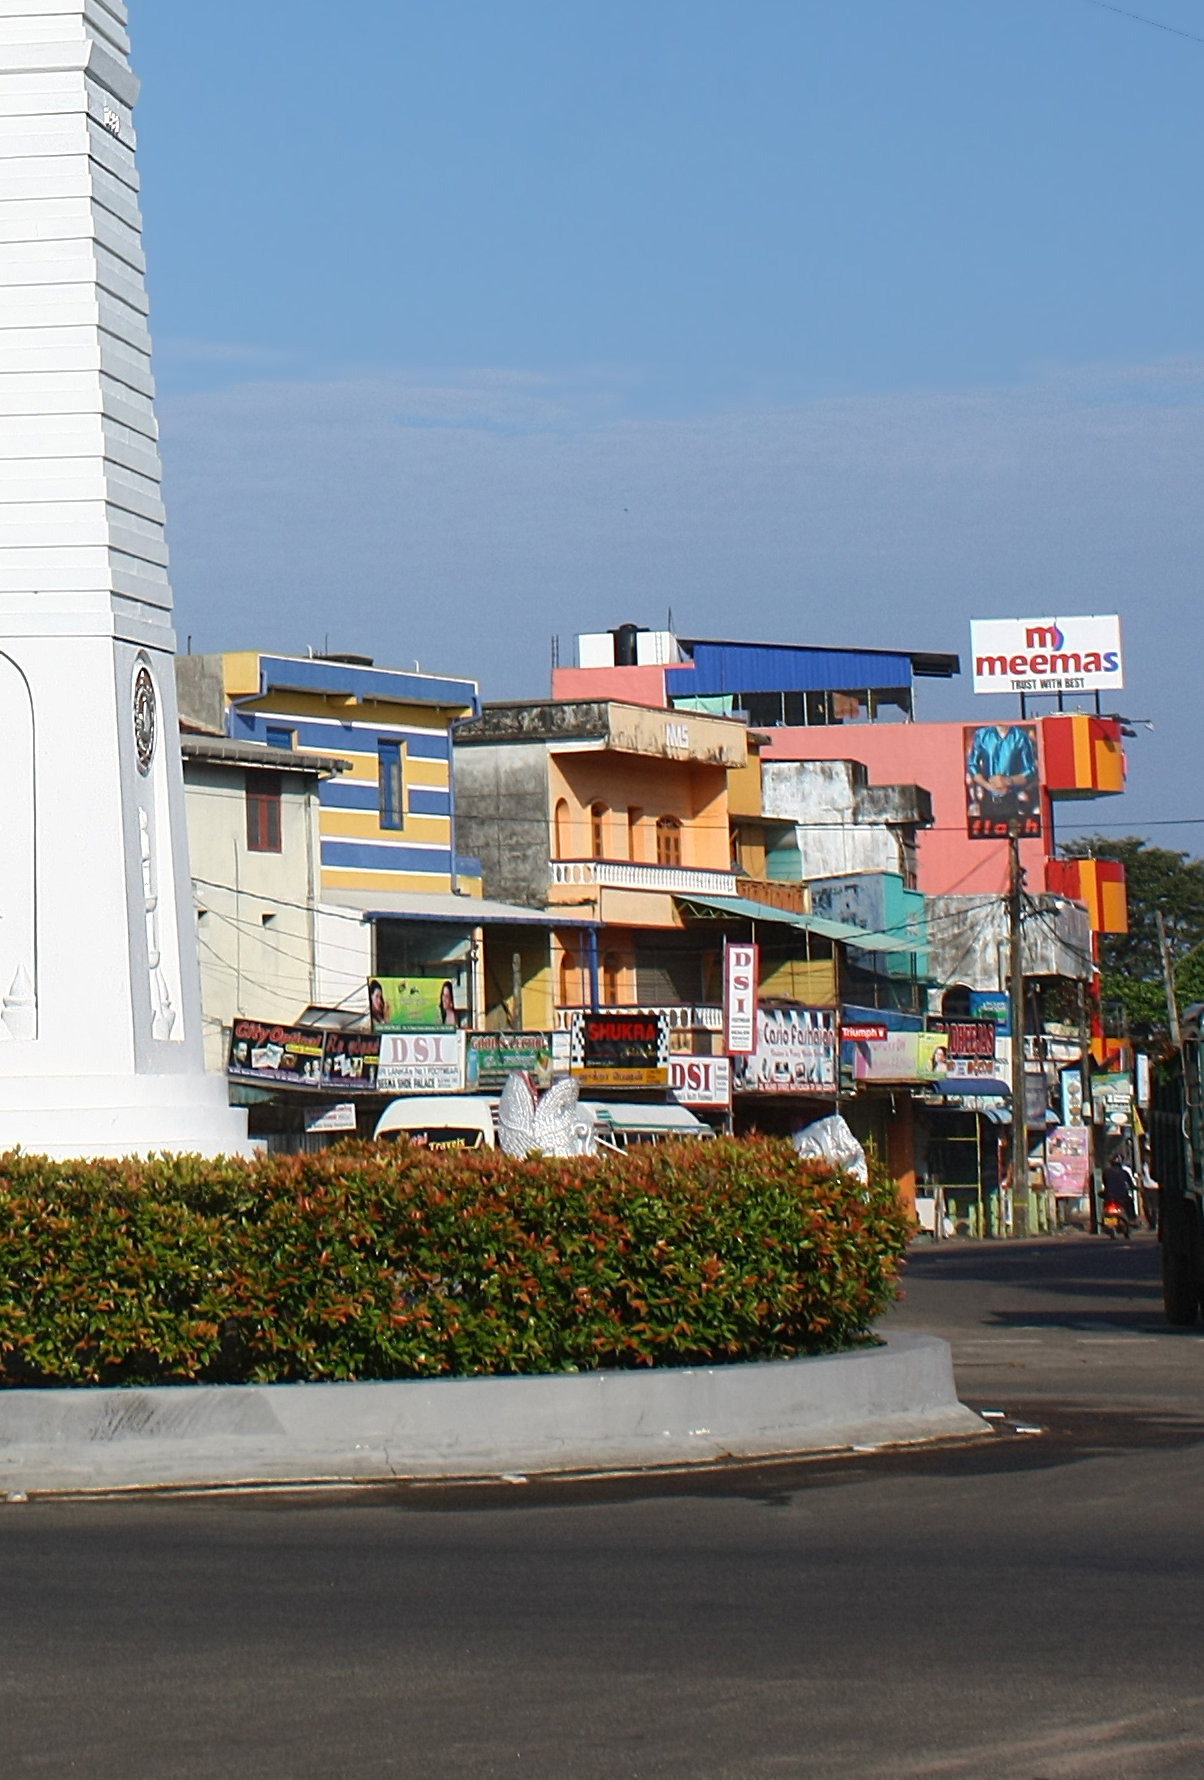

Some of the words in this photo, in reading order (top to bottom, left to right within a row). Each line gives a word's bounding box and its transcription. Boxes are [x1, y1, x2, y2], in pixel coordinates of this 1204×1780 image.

[975, 651, 1119, 676] meemas
[1010, 679, 1037, 690] TRUST
[1040, 678, 1062, 689] WITH
[1065, 677, 1085, 688] BEST
[733, 951, 752, 1014] DSI
[588, 1022, 656, 1040] SHUKRA
[764, 1022, 789, 1045] Casio
[841, 1027, 878, 1038] Triumph
[389, 1036, 444, 1063] DSI
[670, 1062, 712, 1091] DSI
[428, 1137, 466, 1151] Travels
